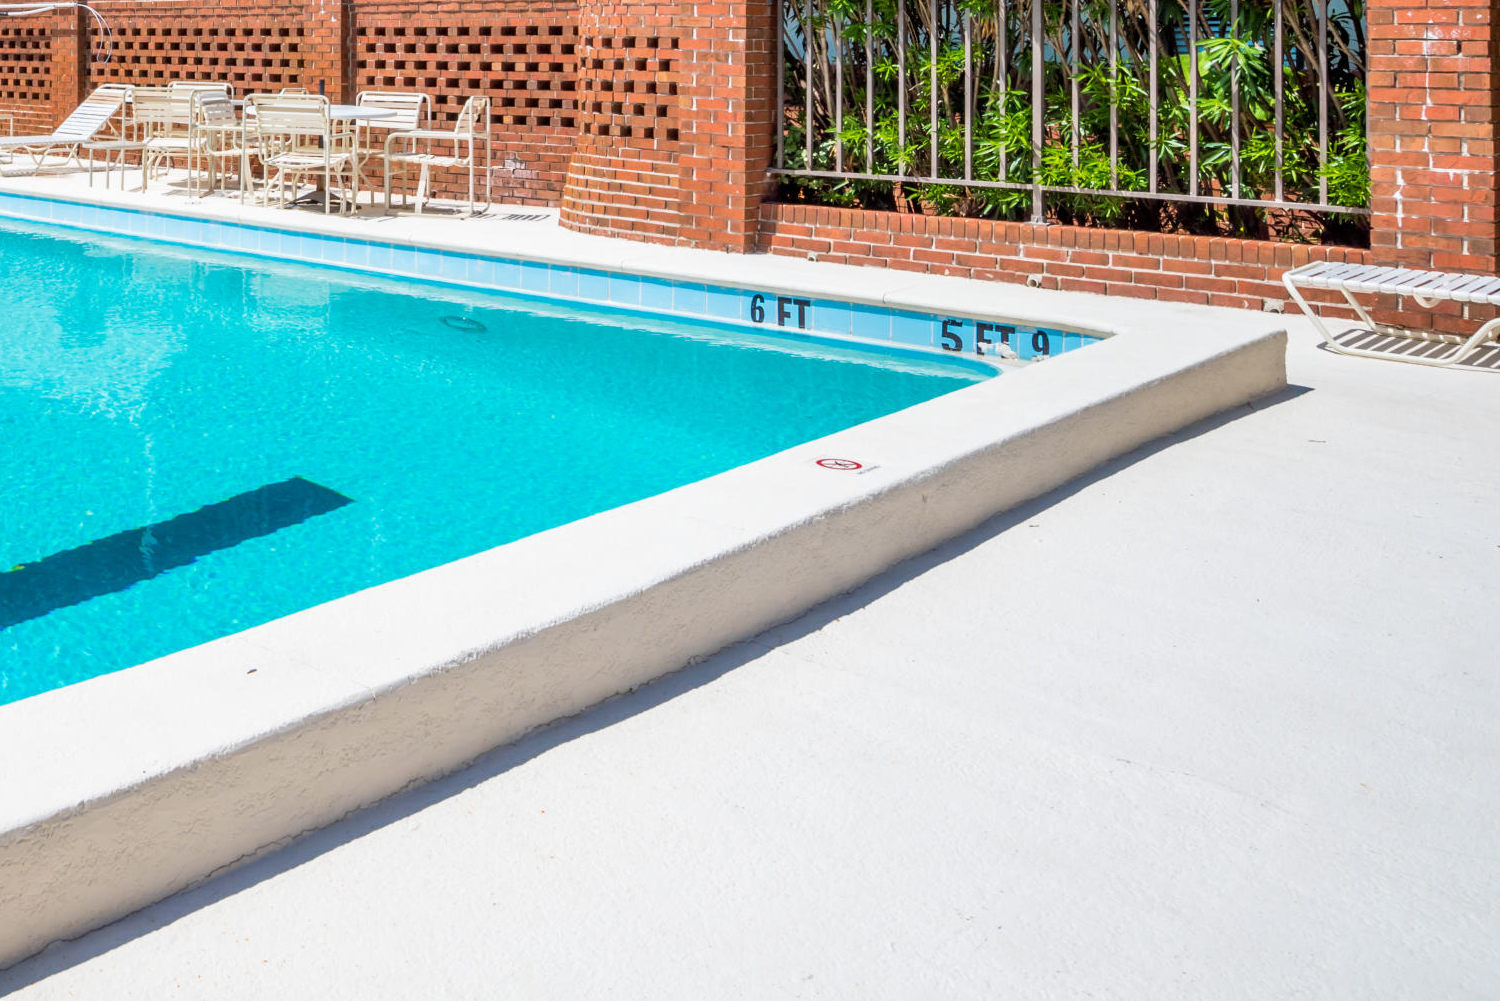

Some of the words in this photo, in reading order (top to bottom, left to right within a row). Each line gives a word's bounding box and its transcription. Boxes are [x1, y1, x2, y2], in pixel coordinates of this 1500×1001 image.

[751, 294, 765, 323] 6
[778, 296, 811, 329] FT
[941, 319, 963, 352] 5
[976, 322, 1016, 359] FT
